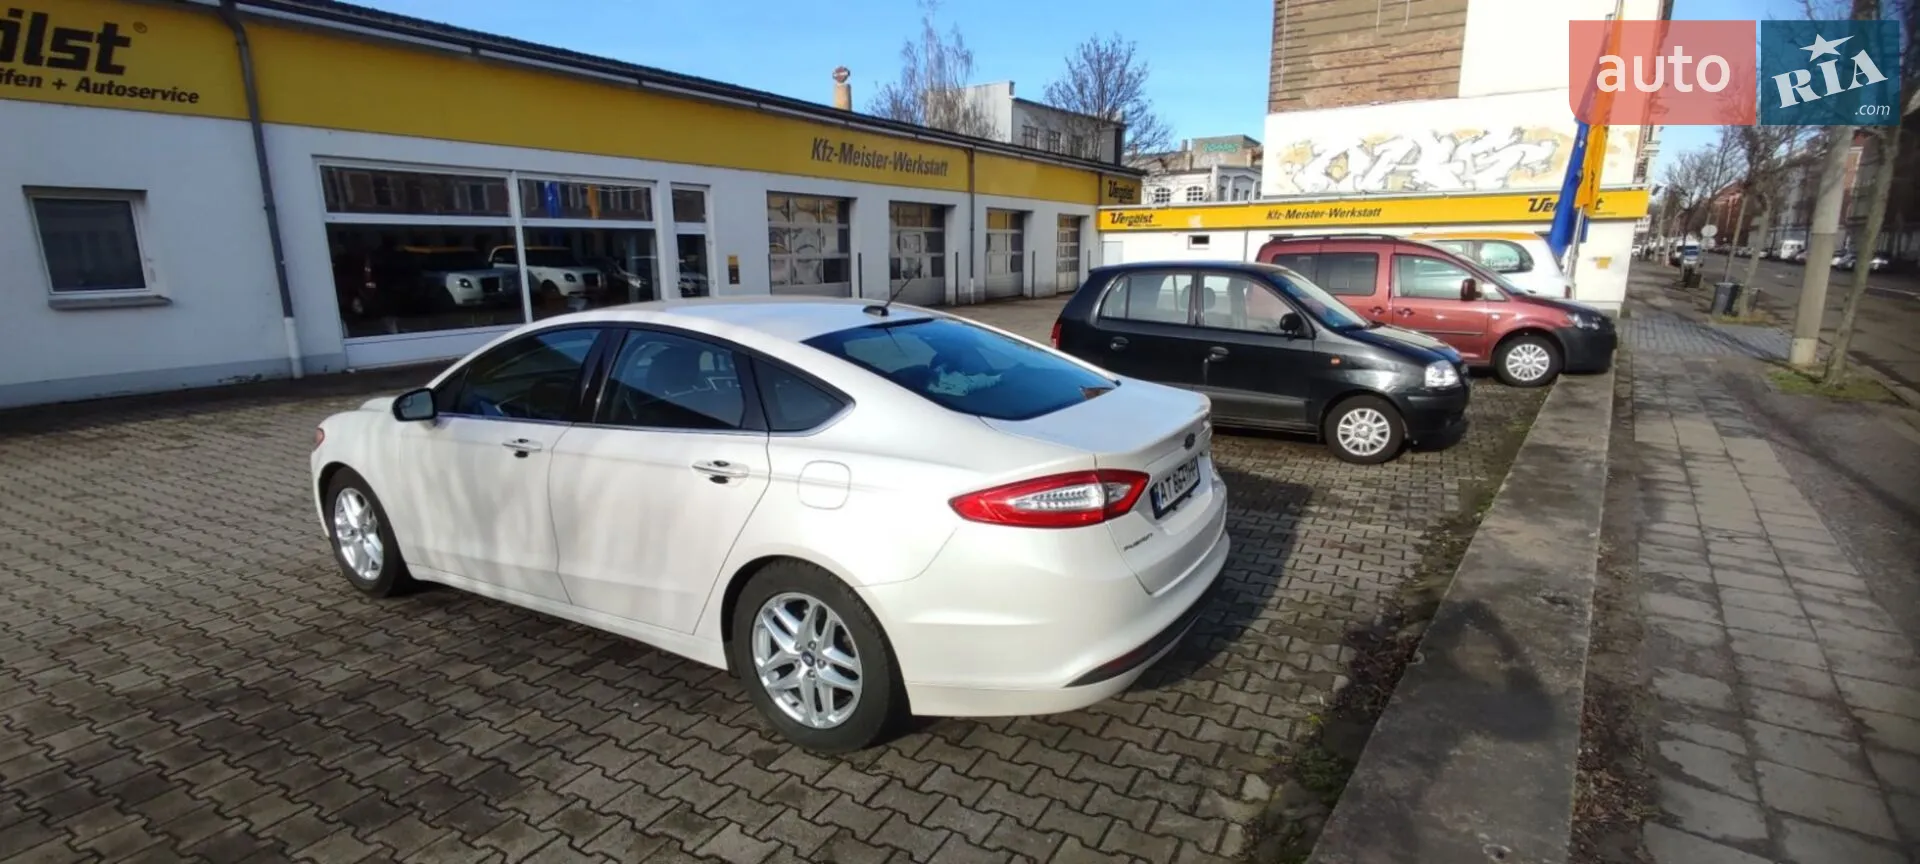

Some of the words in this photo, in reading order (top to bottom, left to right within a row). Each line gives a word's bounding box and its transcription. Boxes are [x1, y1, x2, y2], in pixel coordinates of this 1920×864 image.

[75, 77, 200, 104] Autoservice
[811, 137, 949, 177] Kfz-Meister-Werkstatt
[1266, 207, 1383, 221] Kfz-Meister-Werkstatt
